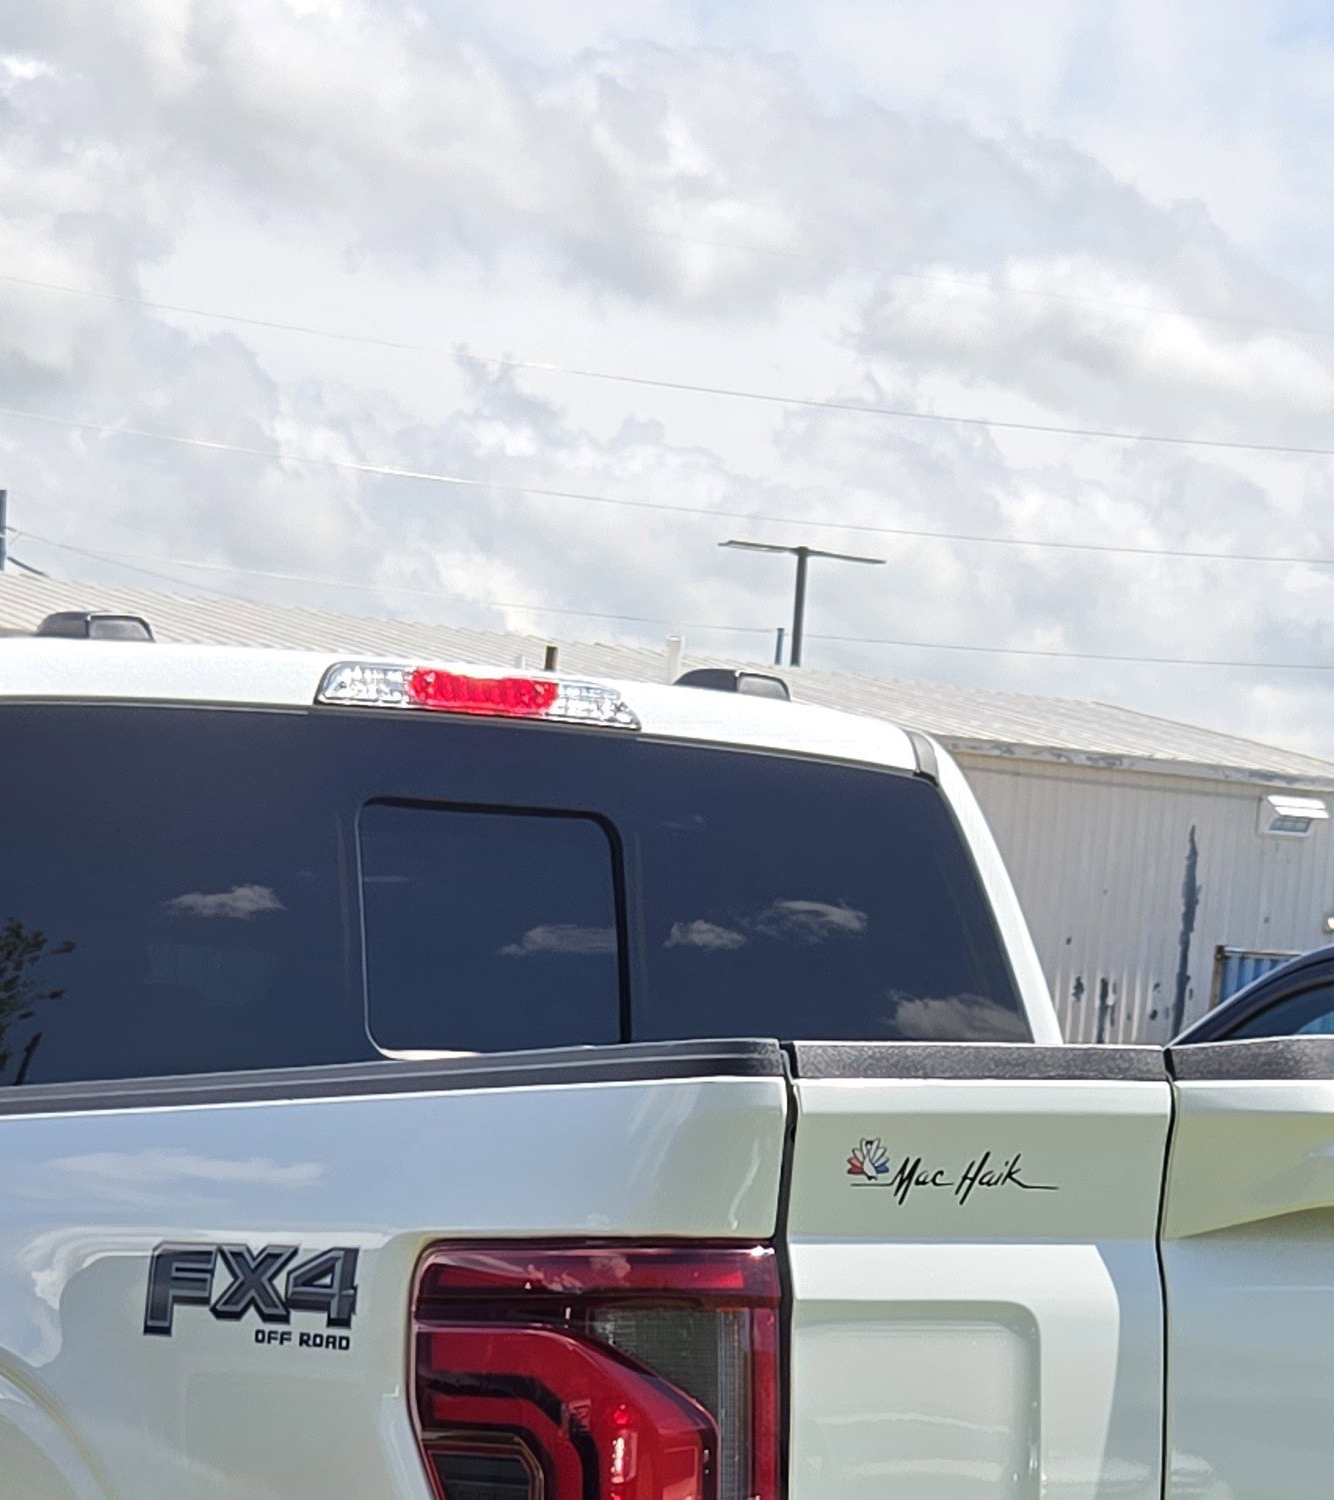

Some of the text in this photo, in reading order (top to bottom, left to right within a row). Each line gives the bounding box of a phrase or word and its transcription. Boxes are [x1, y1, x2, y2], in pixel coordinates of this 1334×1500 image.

[875, 1151, 1043, 1205] Mac Haik
[143, 1241, 361, 1337] FX4
[254, 1329, 351, 1350] OFF ROAD
